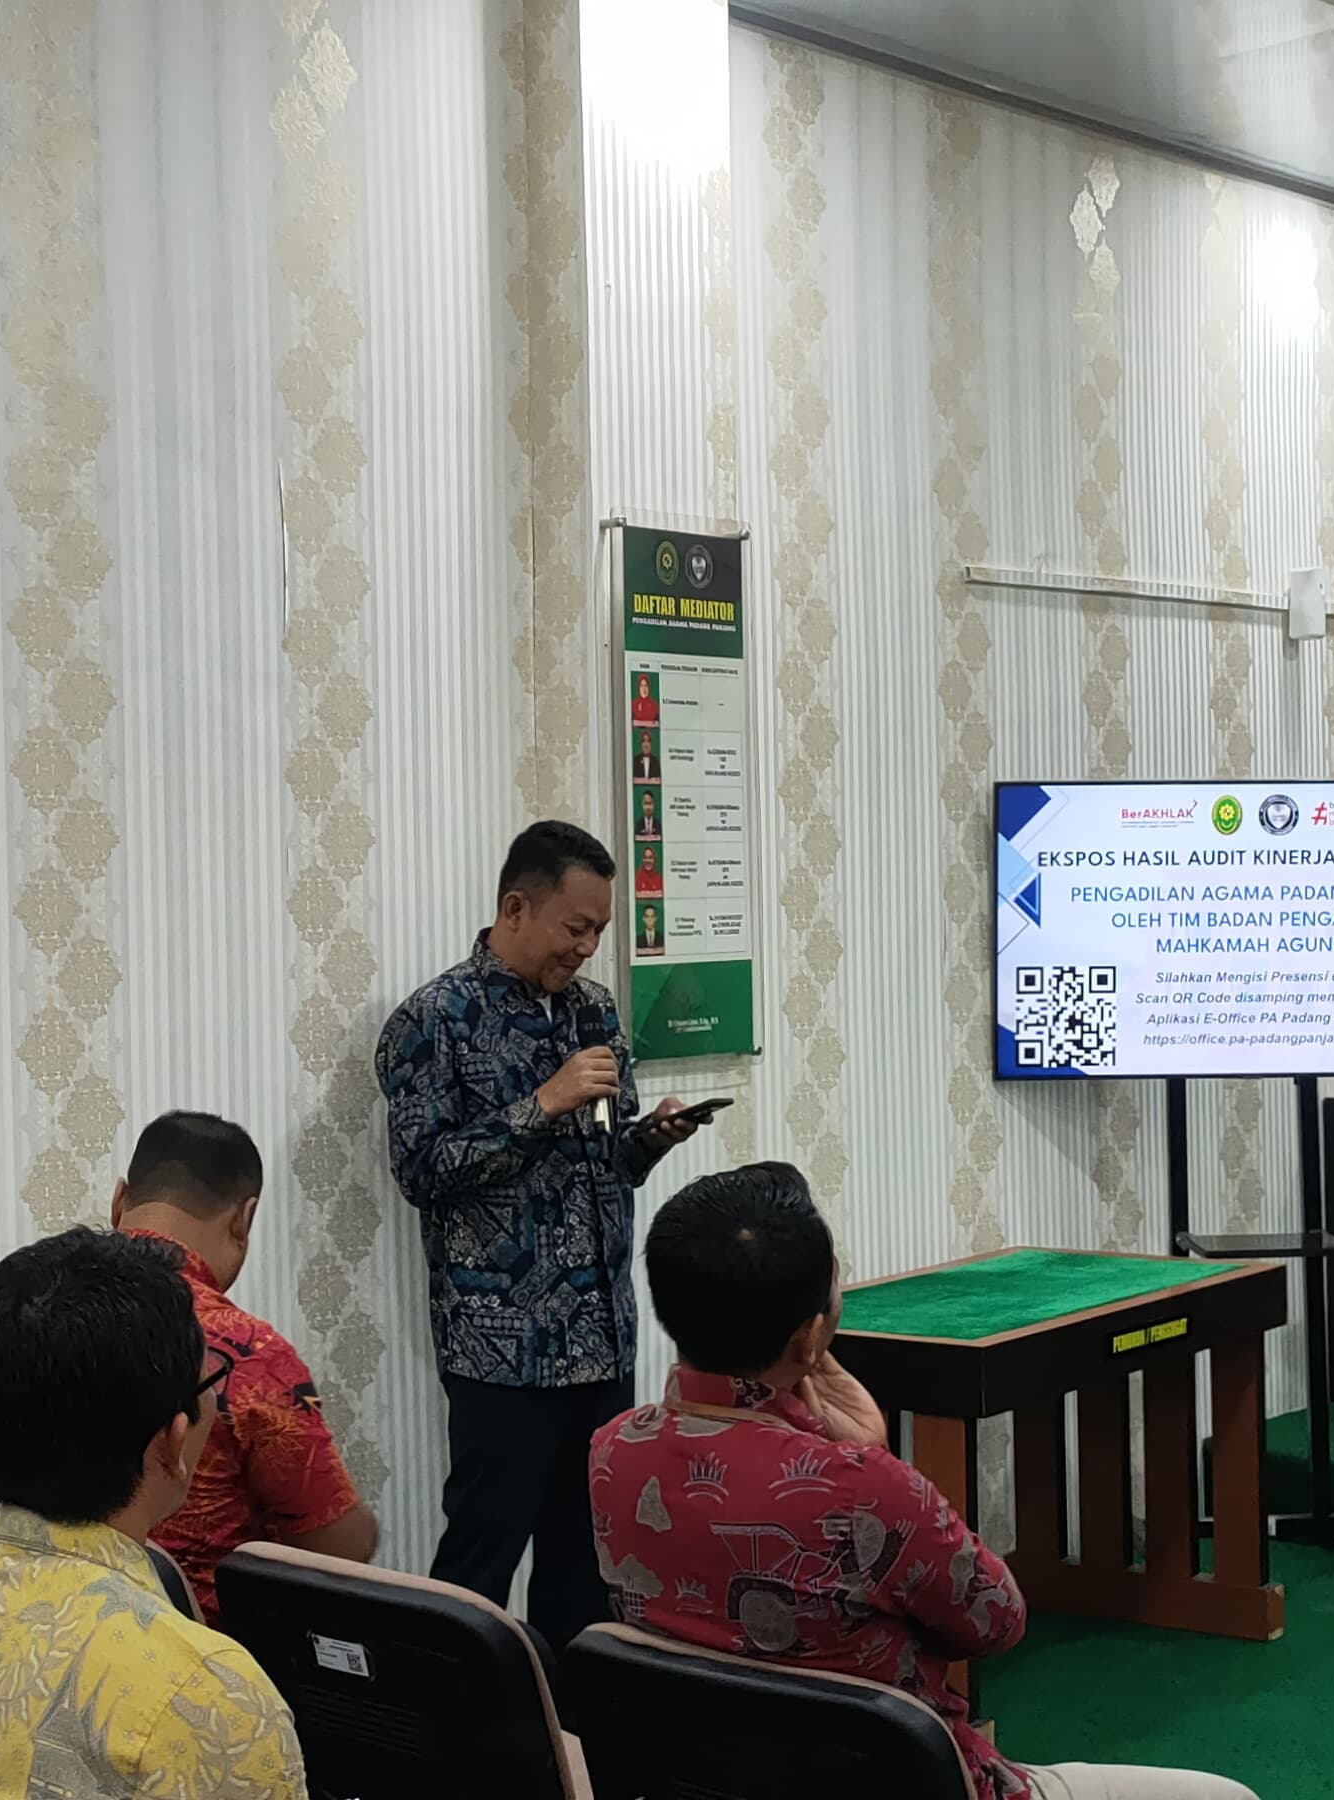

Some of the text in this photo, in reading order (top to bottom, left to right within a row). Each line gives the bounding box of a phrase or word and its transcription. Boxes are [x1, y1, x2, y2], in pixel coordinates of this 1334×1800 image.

[633, 593, 735, 621] DAFTAR MEDIATOR
[1121, 808, 1194, 820] BerAKHLAK
[1038, 851, 1116, 866] EKSPOS
[1123, 851, 1180, 866] HASIL
[1188, 850, 1247, 866] AUDIT
[1071, 887, 1195, 902] PENGADILAN
[1201, 886, 1274, 901] AGAMA
[1111, 913, 1162, 928] OLEH
[1168, 912, 1200, 927] TIM
[1207, 912, 1272, 927] BADAN
[1156, 939, 1270, 953] MAHKAMAH
[1156, 972, 1212, 983] Silahkan
[1216, 971, 1268, 984] Mengisi
[1271, 971, 1329, 982] Presensi
[1136, 992, 1168, 1004] Scan
[1172, 993, 1193, 1003] QR
[1197, 992, 1231, 1003] Code
[1235, 992, 1304, 1005] disamping
[1147, 1013, 1200, 1027] Aplikasi
[1204, 1012, 1256, 1024] E-Office
[1260, 1012, 1278, 1023] PA
[1282, 1012, 1331, 1025] Padang
